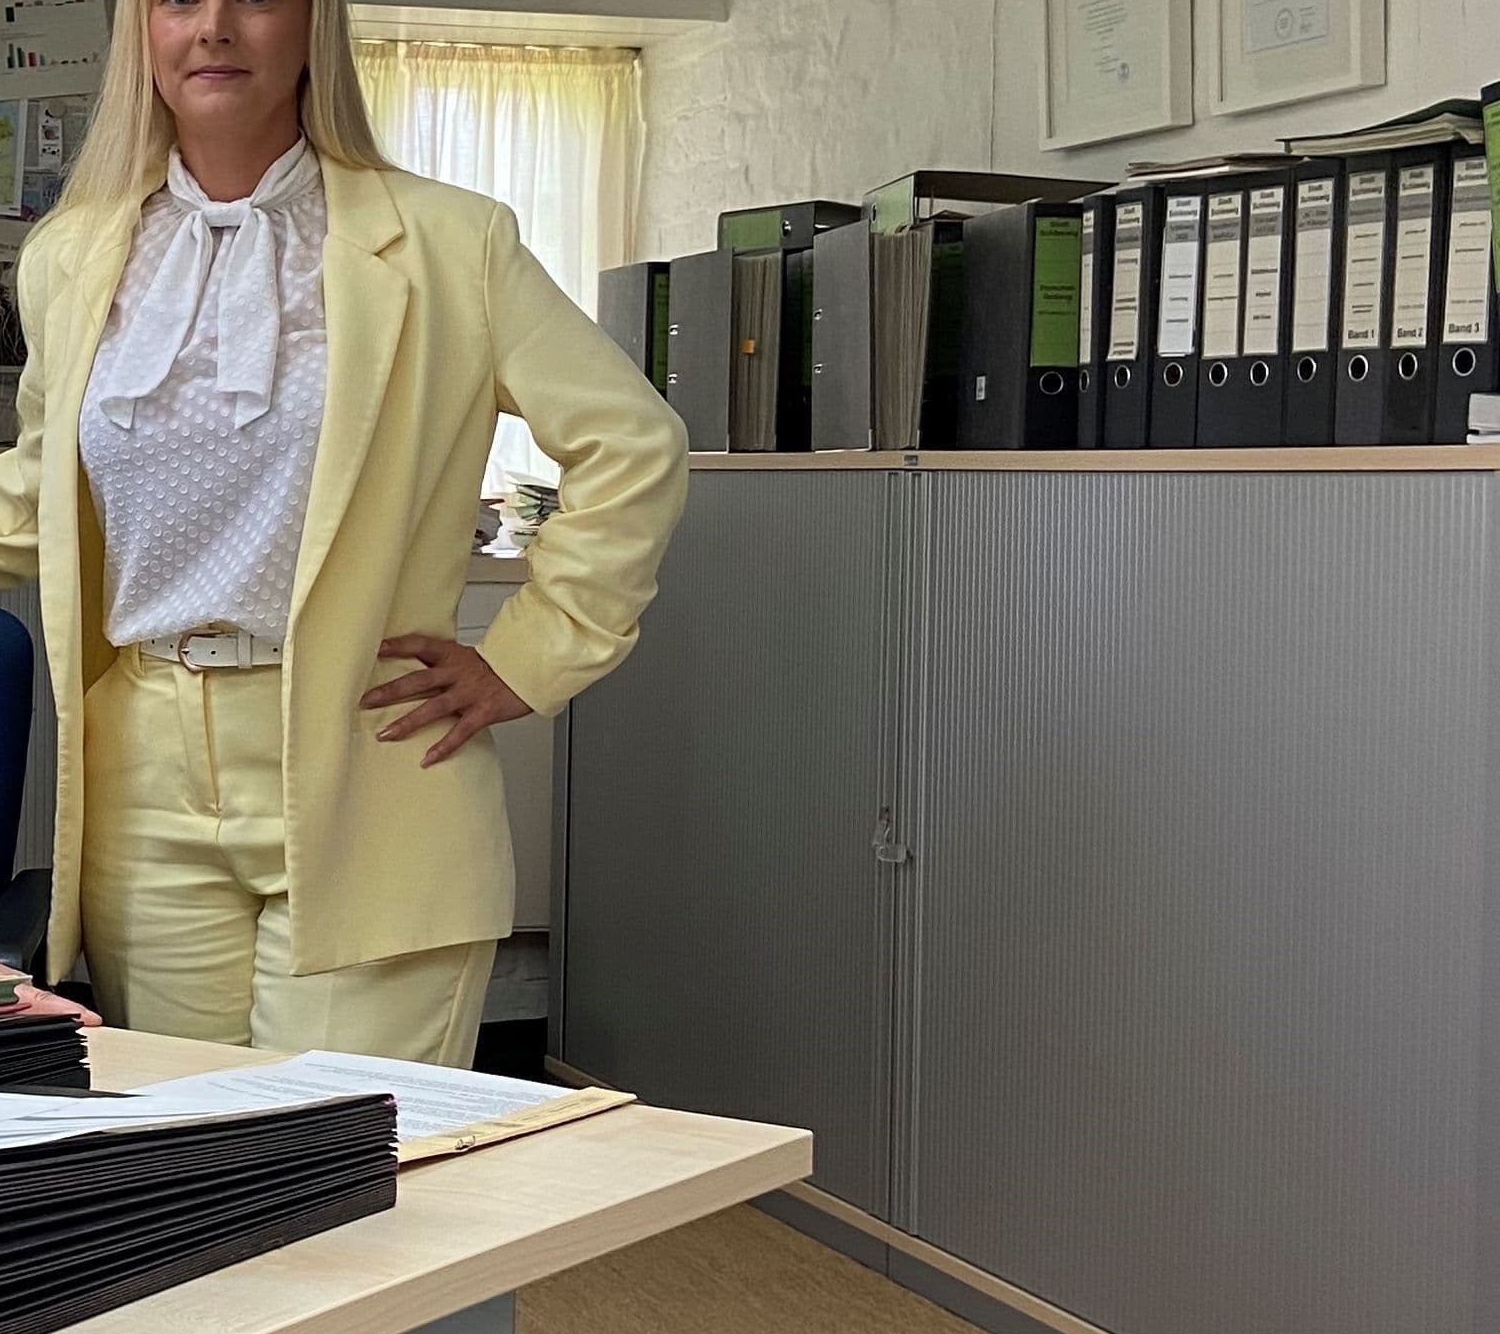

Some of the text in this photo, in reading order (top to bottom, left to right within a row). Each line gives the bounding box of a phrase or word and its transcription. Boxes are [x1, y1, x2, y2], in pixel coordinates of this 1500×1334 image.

[1348, 329, 1369, 339] Band
[1397, 329, 1417, 338] Band
[1449, 324, 1474, 334] Band
